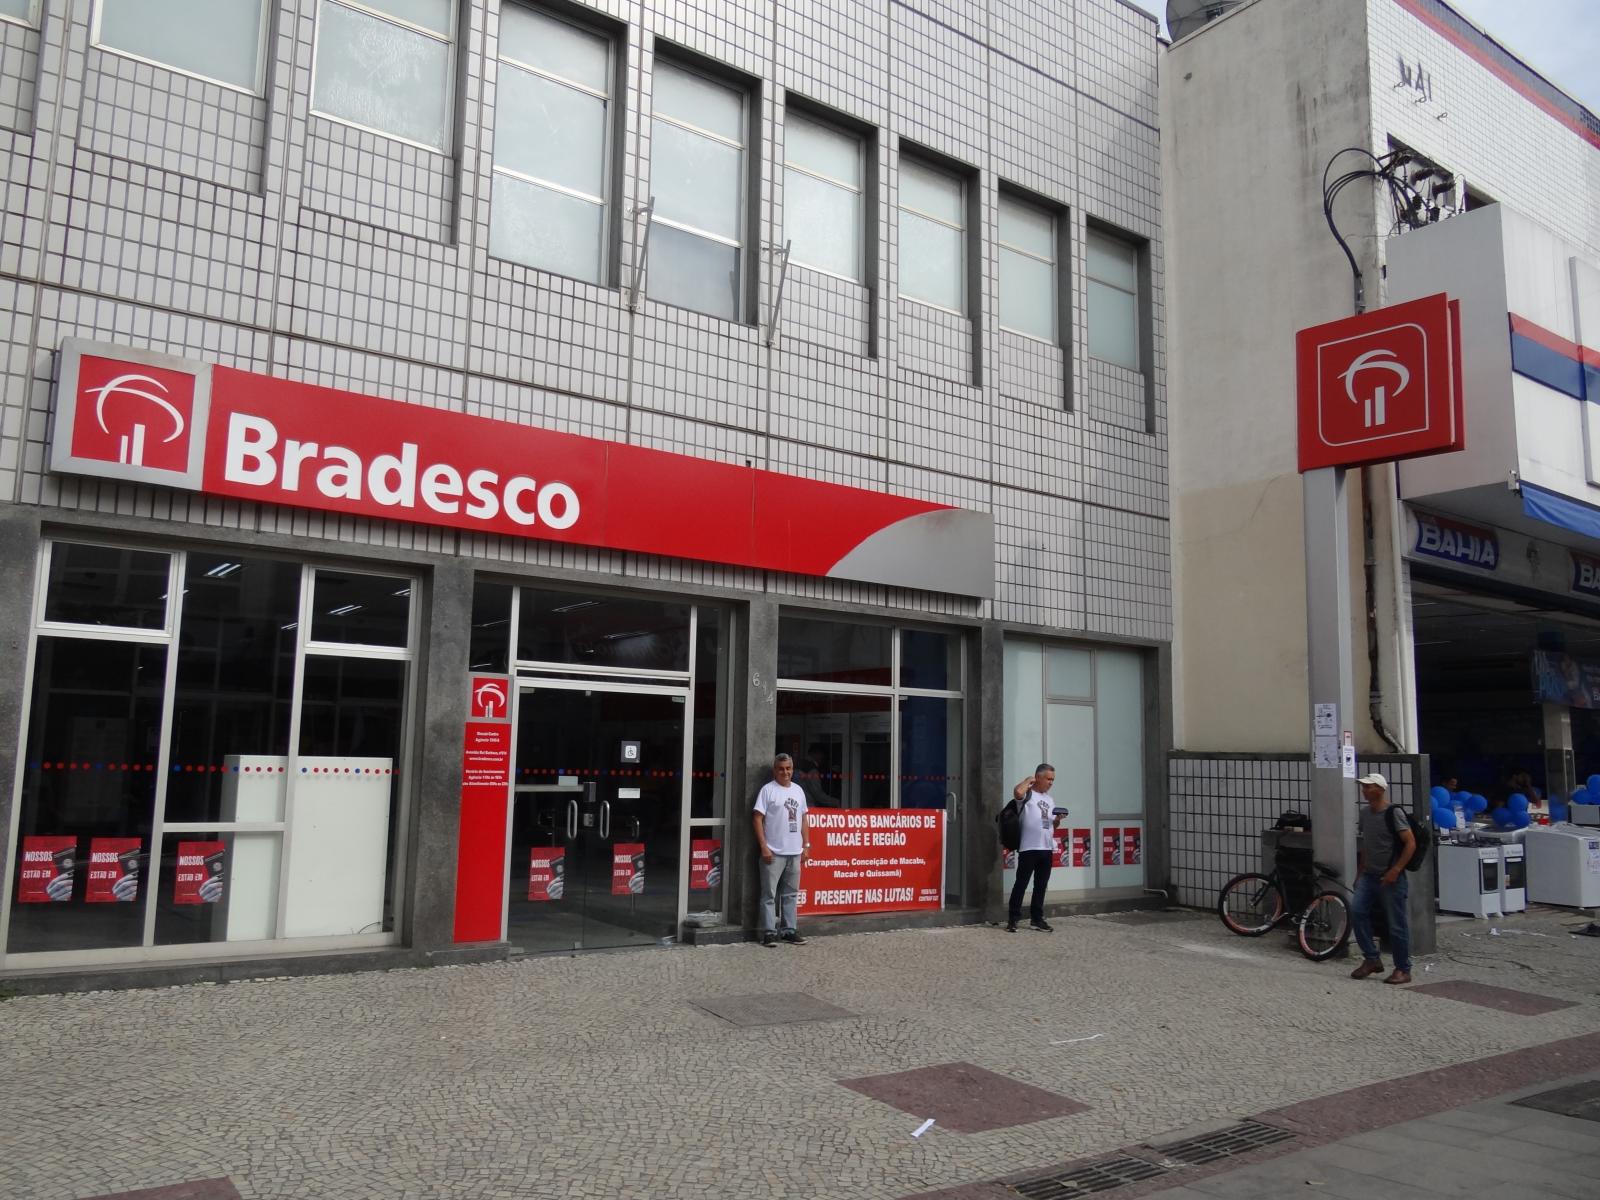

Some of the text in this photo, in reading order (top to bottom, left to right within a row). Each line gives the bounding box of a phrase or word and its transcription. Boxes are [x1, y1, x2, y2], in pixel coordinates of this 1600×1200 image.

[224, 411, 581, 530] Bradesco
[1420, 522, 1496, 566] BAHIA
[807, 814, 846, 828] DICATO
[848, 814, 868, 828] DOS
[870, 812, 922, 828] BANCÁRIOS
[924, 815, 936, 828] DE
[827, 830, 907, 846] MACAÉ E REGIÃO
[25, 851, 53, 862] NOSSOS
[91, 852, 119, 863] NOSSOS
[179, 855, 204, 866] NOSSOS
[889, 858, 898, 866] de
[814, 887, 914, 905] PRESENTE NAS LUTAS!
